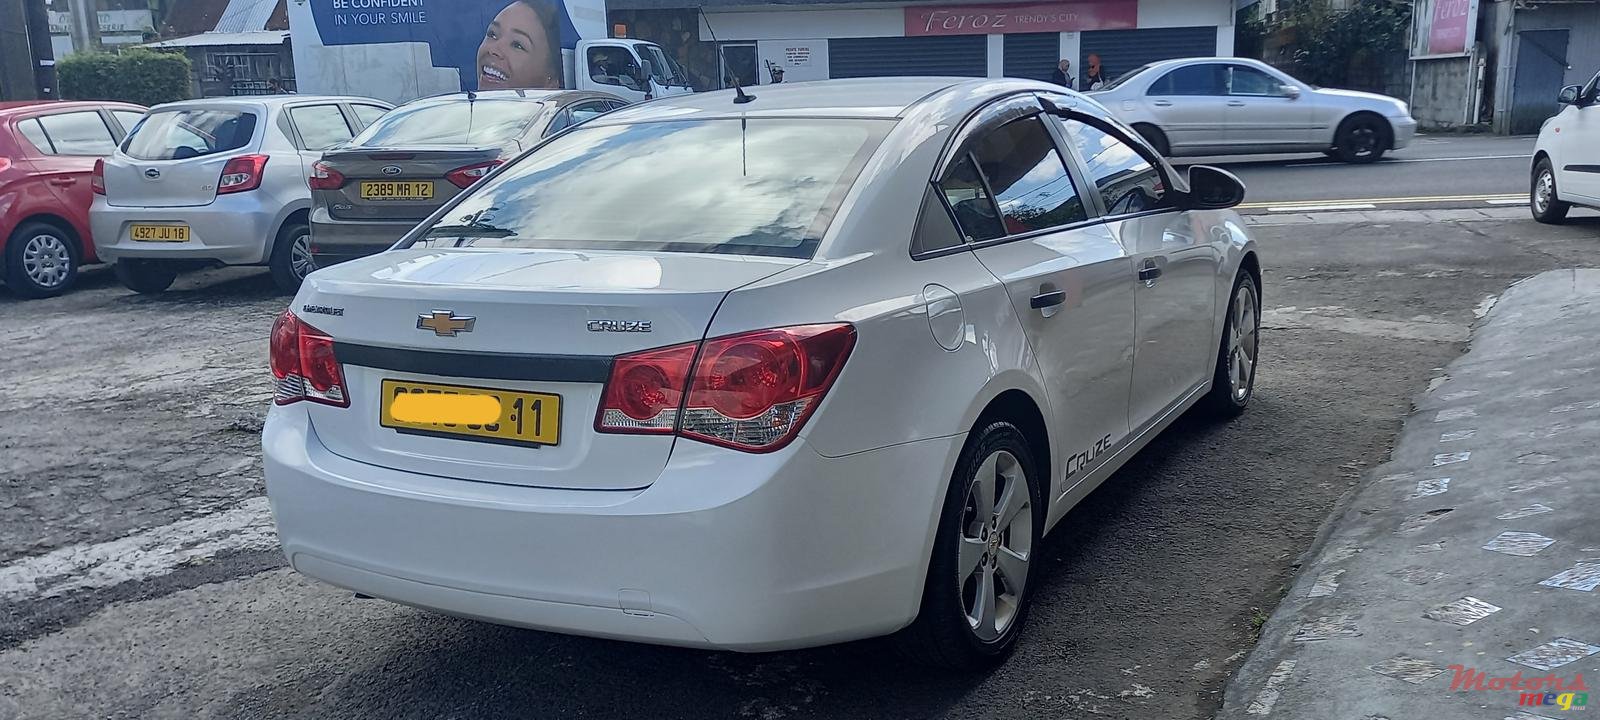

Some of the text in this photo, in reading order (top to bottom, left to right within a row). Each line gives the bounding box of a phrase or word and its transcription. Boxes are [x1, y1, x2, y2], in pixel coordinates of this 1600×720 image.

[333, 0, 424, 9] BE CONFIDENT
[334, 12, 426, 25] IN YOUR SMILE
[921, 10, 1008, 32] Feroz
[1058, 13, 1079, 23] CITY
[366, 183, 428, 197] 2389 MR 12
[134, 227, 185, 240] 4927 JU 18
[587, 319, 652, 333] CRUZE
[512, 397, 543, 437] 11
